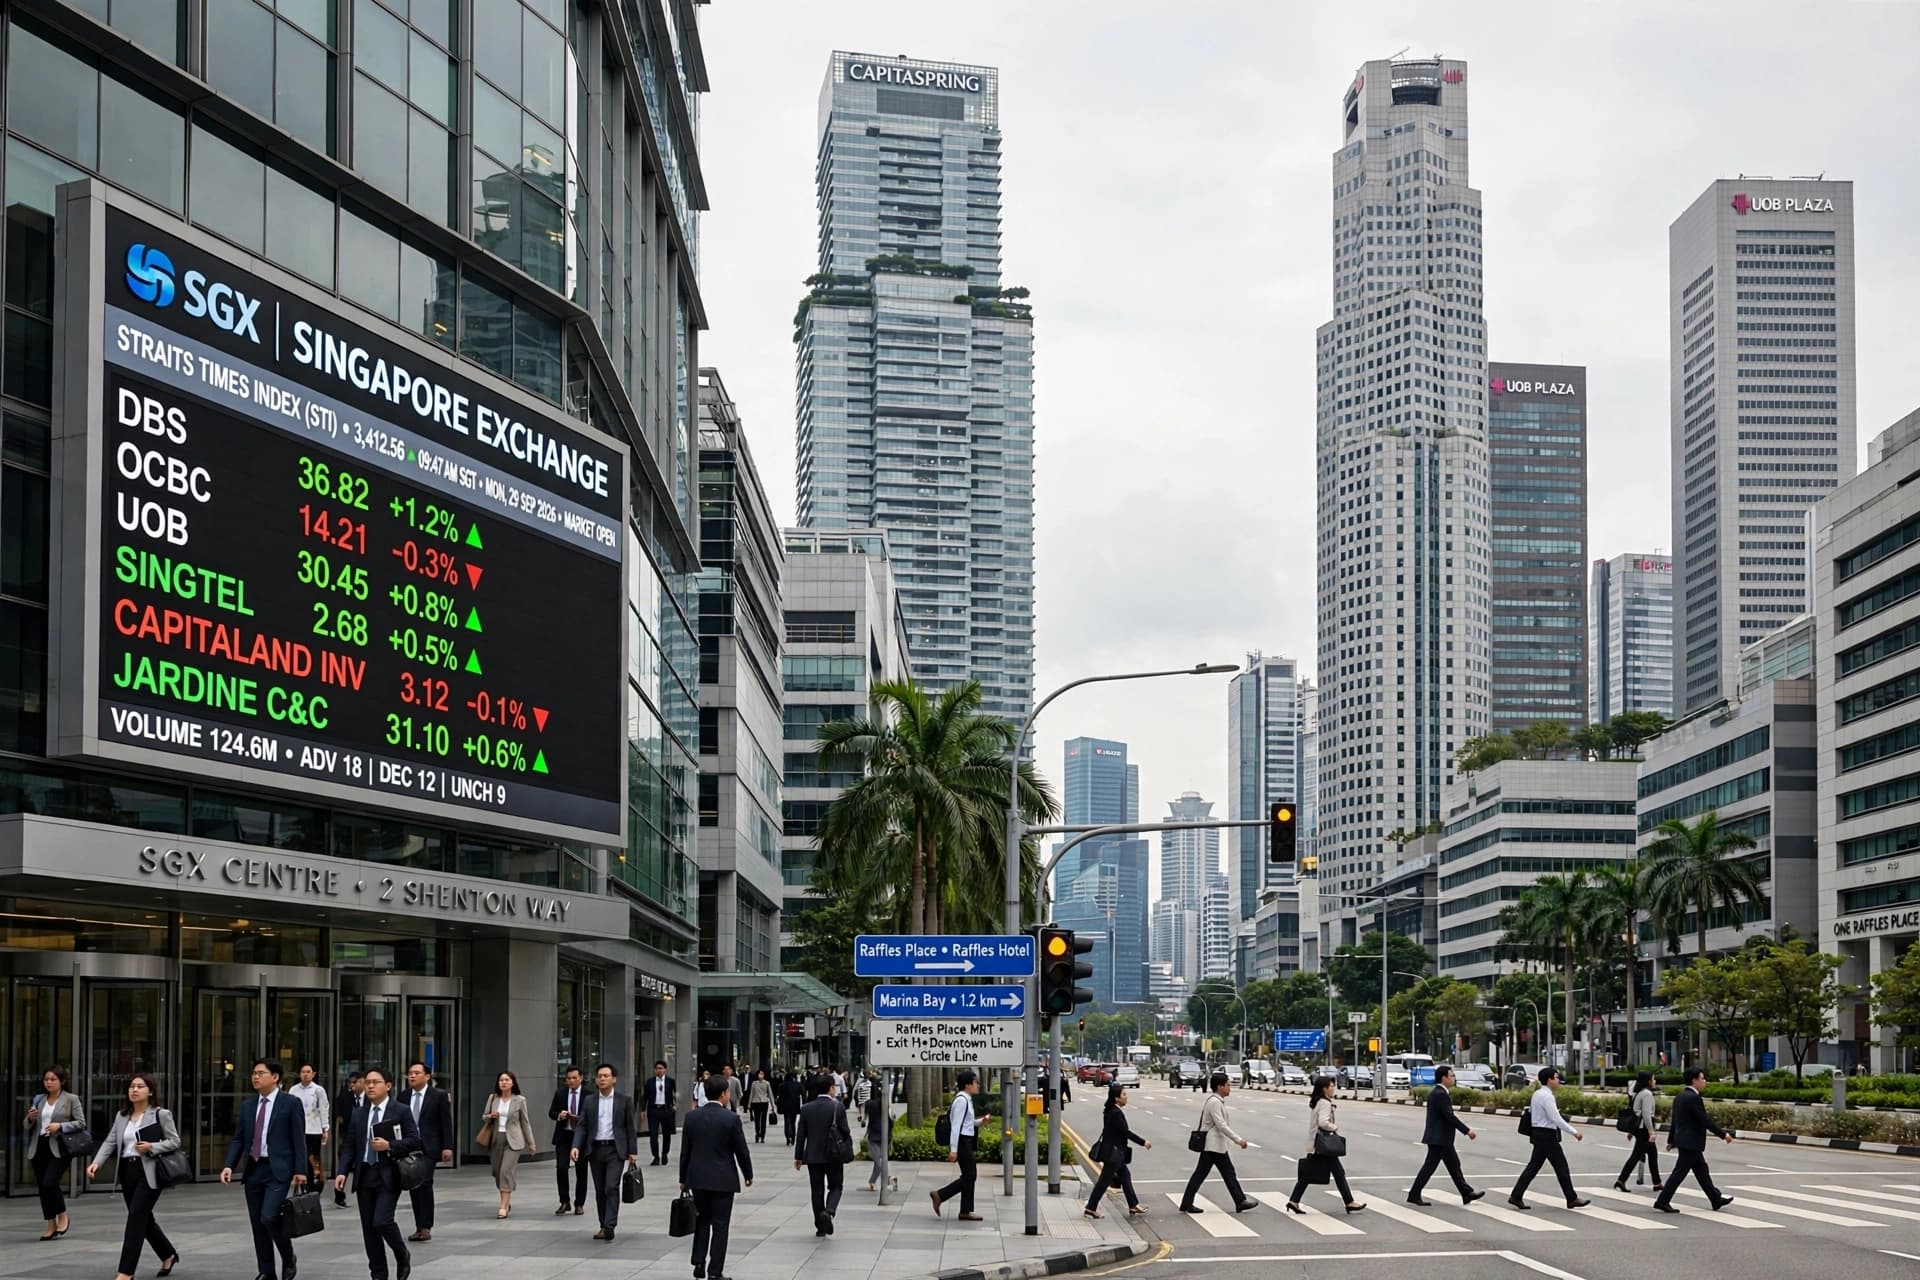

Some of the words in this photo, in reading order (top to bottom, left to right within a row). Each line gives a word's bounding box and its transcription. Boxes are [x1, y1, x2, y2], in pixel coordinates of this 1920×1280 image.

[850, 63, 979, 92] CAPITASPRING
[1751, 197, 1781, 211] UOB
[1785, 198, 1834, 212] PLAZA
[184, 270, 261, 344] SGX
[293, 321, 469, 435] SINGAPORE
[477, 404, 609, 497] EXCHANGE
[1506, 380, 1532, 393] UOB
[1535, 382, 1575, 396] PLAZA
[117, 324, 195, 376] STRAITS
[199, 356, 250, 398] TIMES
[254, 379, 301, 420] INDEX
[305, 401, 338, 439] (STI)
[354, 423, 405, 462] 3,412.56
[443, 461, 459, 483] AM
[459, 468, 477, 489] SGT
[486, 476, 507, 507] MON,
[508, 487, 519, 507] 29
[519, 491, 536, 514] SEP
[564, 511, 596, 540] MARKET
[596, 526, 616, 548] OPEN
[118, 387, 187, 444] DBS
[298, 457, 370, 511] 36.82
[389, 496, 459, 543] +1.2%
[117, 442, 212, 503] OCBC
[299, 504, 367, 555] 14.21
[392, 541, 459, 585] -0.3%
[117, 492, 189, 546] UOB
[297, 550, 369, 600] 30.45
[389, 585, 458, 628] +0.8%
[115, 545, 254, 616] SINGTEL
[312, 602, 368, 646] 2.68
[389, 629, 458, 671] +0.5%
[114, 598, 312, 677] CAPITALAND
[321, 650, 366, 691] INV
[400, 672, 449, 711] 3.12
[467, 691, 527, 730] -0.1%
[113, 652, 257, 715] JARDINE
[266, 686, 329, 729] C&C
[386, 713, 450, 756] 31.10
[463, 735, 527, 772] +0.6%
[111, 707, 202, 747] VOLUME
[210, 727, 278, 762] 124.6M
[300, 746, 337, 773] ADV
[343, 754, 362, 778] 18
[379, 761, 412, 788] DEC
[418, 770, 436, 792] 12
[451, 775, 493, 803] UNCH
[496, 785, 506, 805] 9
[139, 846, 207, 881] SGX
[222, 857, 340, 896] CENTRE
[379, 877, 395, 901] 2
[404, 880, 517, 916] SHENTON
[526, 896, 571, 923] WAY
[860, 943, 901, 957] Raffles
[905, 943, 937, 957] Place
[952, 943, 994, 957] Raffles
[999, 943, 1030, 957] Hotel
[1833, 921, 1851, 937] ONE
[1853, 916, 1888, 935] RAFFLES
[1891, 911, 1919, 928] PLACE
[880, 993, 919, 1007] Marina
[923, 994, 946, 1010] Bay
[960, 994, 976, 1007] 1.2
[980, 993, 997, 1007] km
[896, 1023, 933, 1035] Raffles
[937, 1023, 966, 1035] Place
[970, 1023, 995, 1035] MRT
[886, 1037, 907, 1048] Exit
[929, 1037, 987, 1048] Downtown
[991, 1038, 1014, 1048] Line
[920, 1050, 950, 1061] Circle
[955, 1050, 978, 1061] Line
